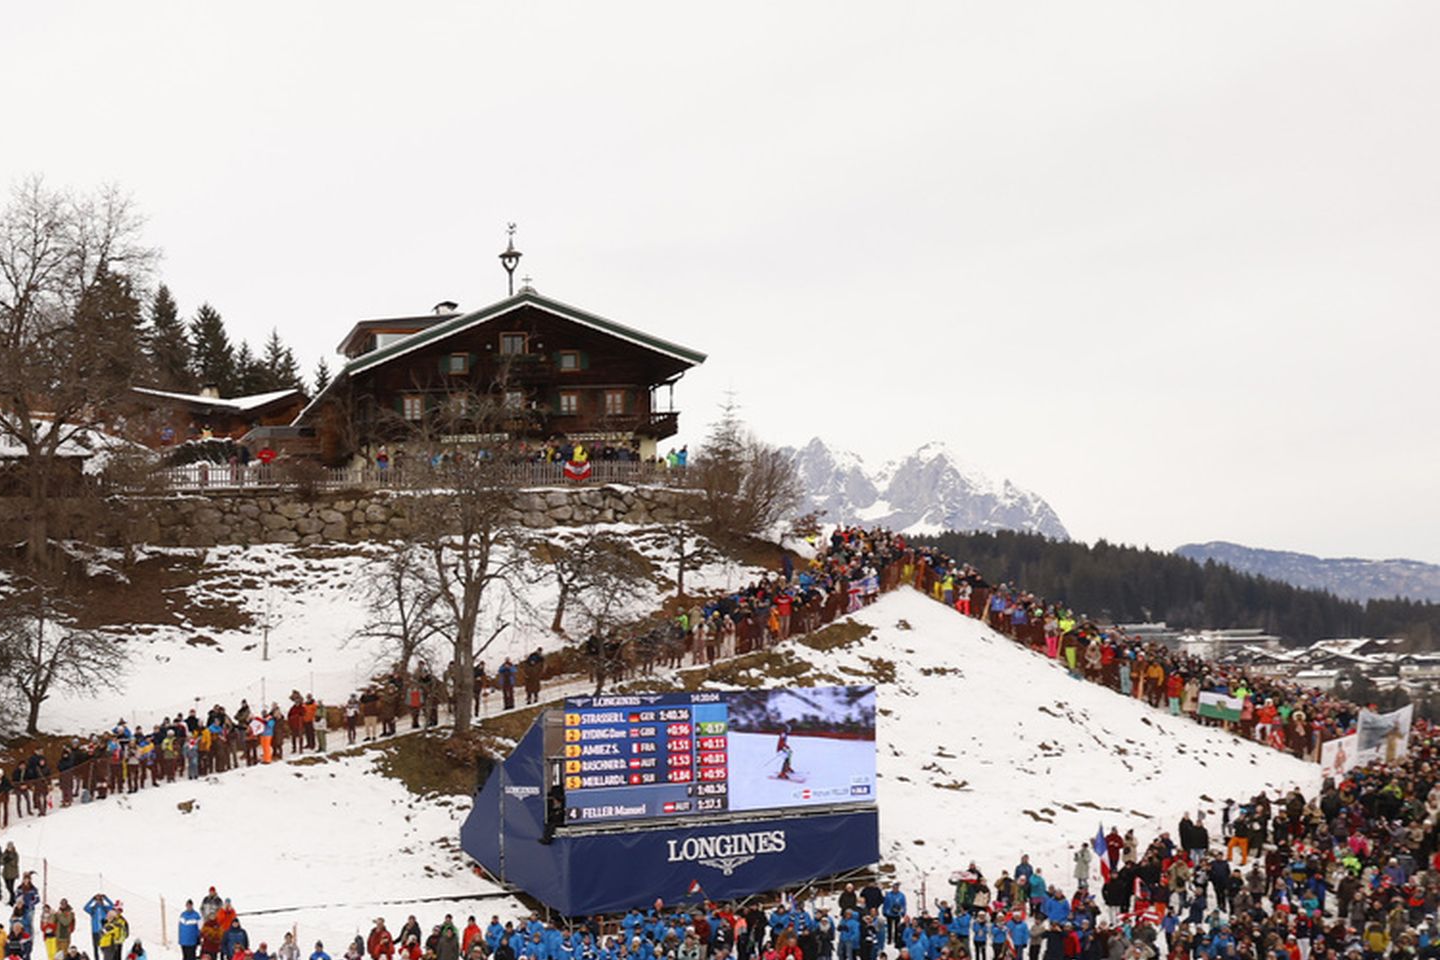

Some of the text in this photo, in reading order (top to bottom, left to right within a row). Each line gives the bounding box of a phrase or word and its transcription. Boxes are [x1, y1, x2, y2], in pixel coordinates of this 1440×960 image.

[593, 696, 641, 707] LONGINES
[581, 713, 619, 725] STRASSER
[640, 712, 656, 721] GER
[641, 742, 656, 752] FRA
[641, 758, 656, 768] AUT
[569, 808, 577, 819] 4
[582, 805, 615, 819] FELLER
[666, 830, 786, 861] LONGINES
